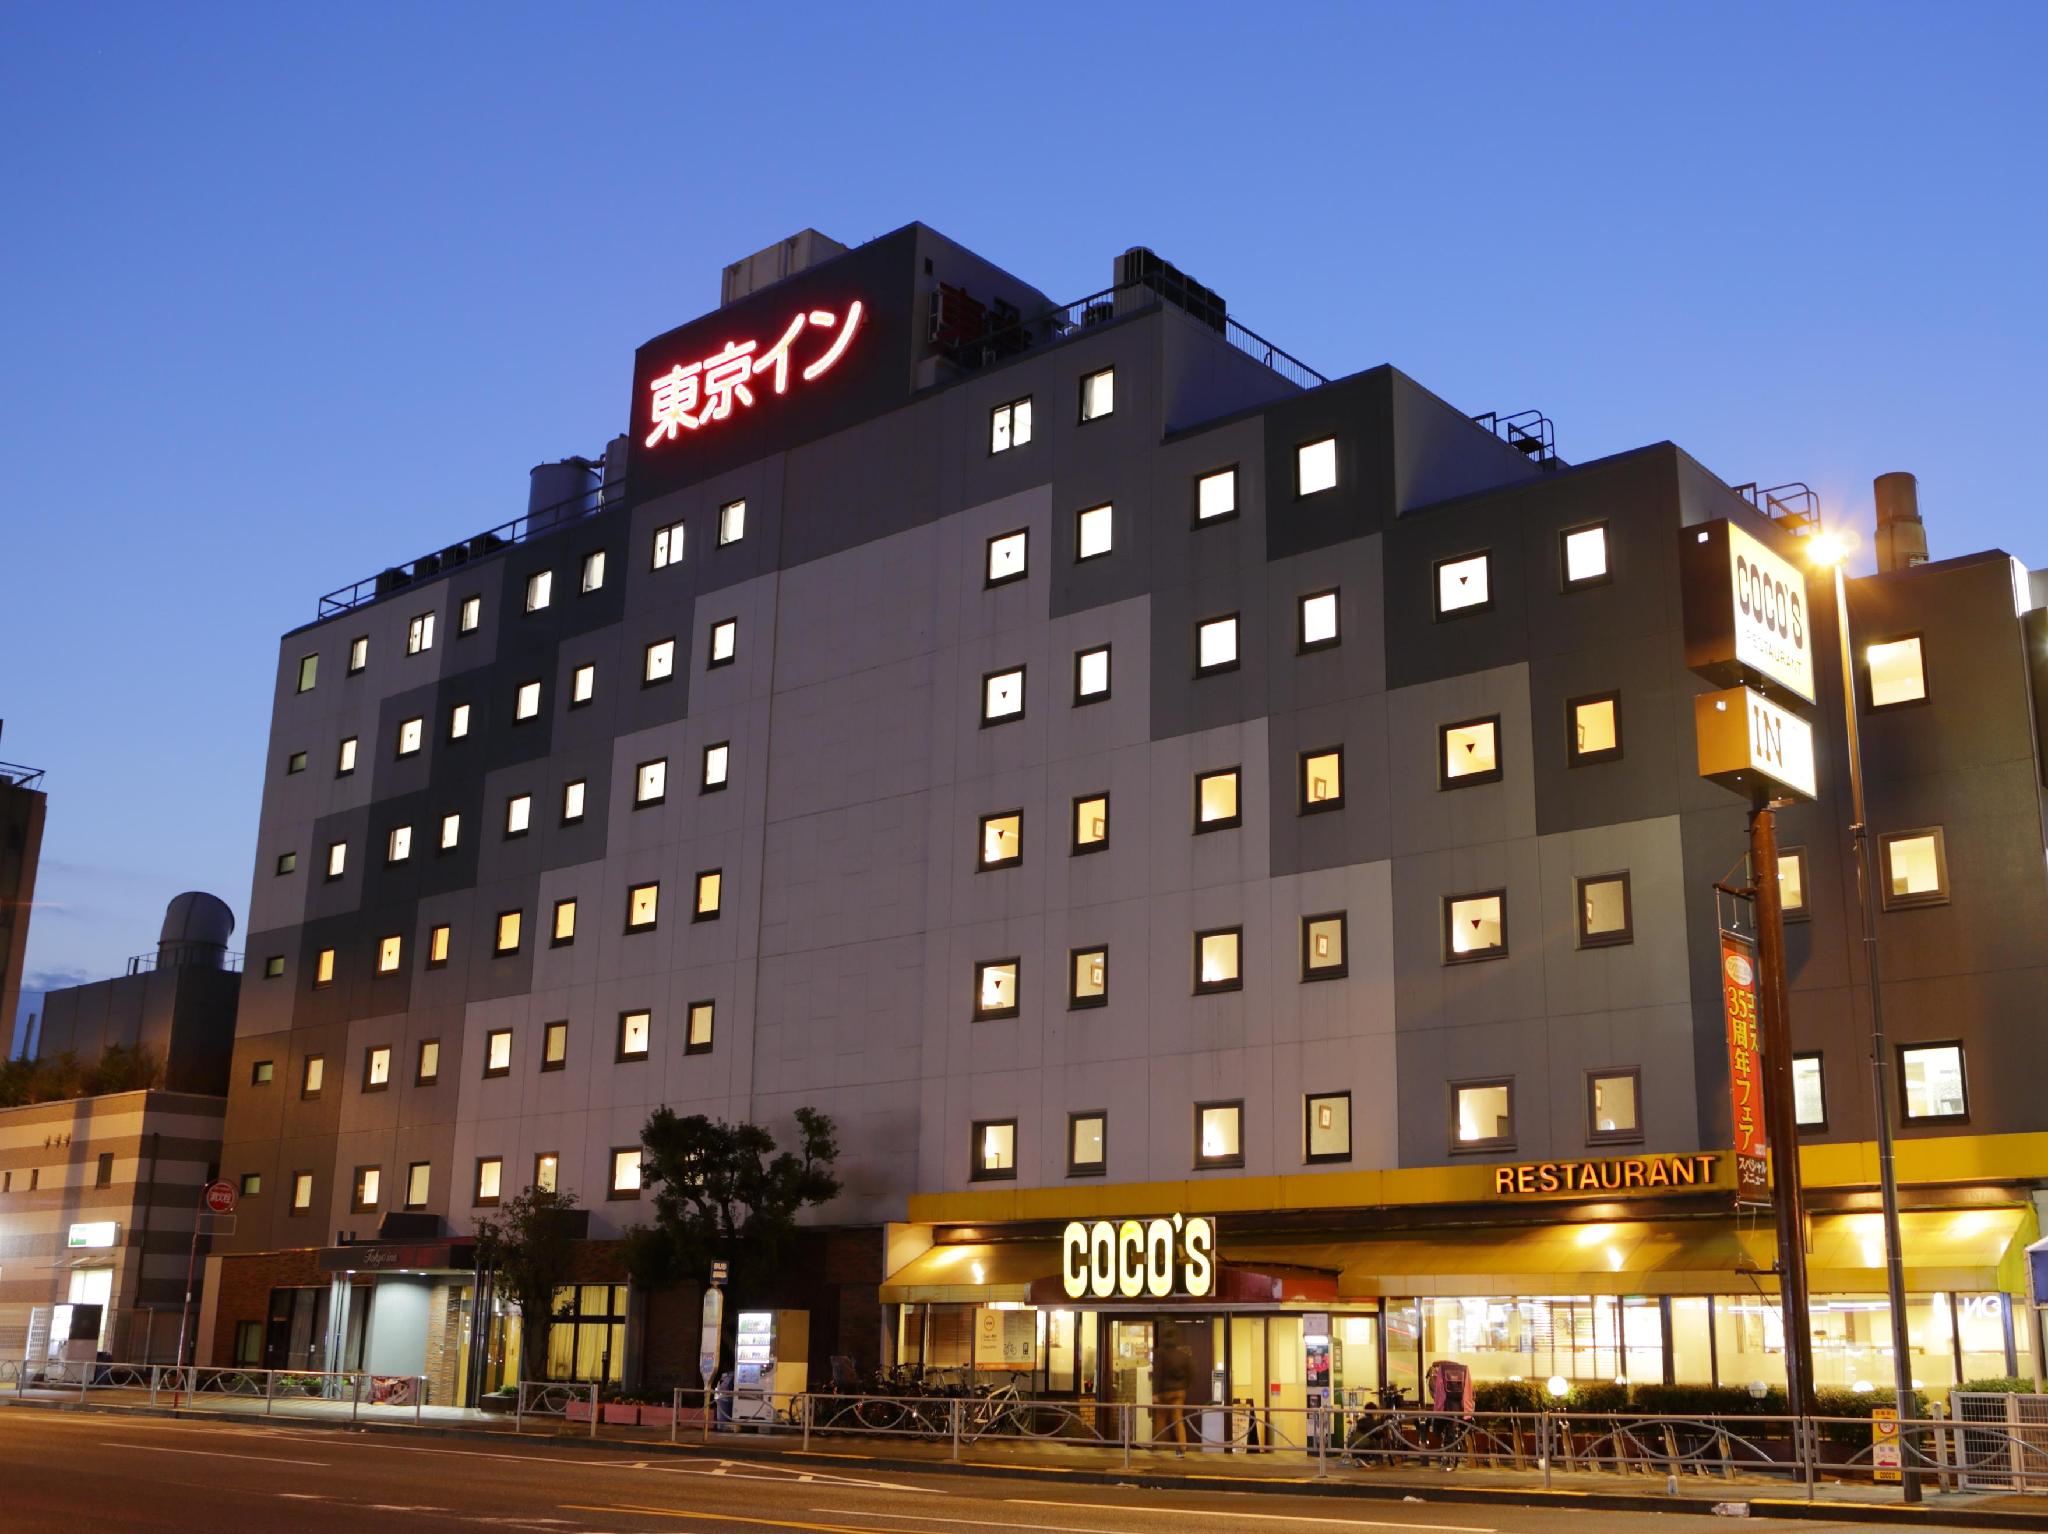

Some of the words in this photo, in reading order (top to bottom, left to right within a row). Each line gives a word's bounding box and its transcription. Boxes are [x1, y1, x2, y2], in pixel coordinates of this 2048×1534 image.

[645, 300, 863, 449] 東京イン
[1737, 554, 1803, 650] COCO'S
[1728, 985, 1754, 1152] 35周年フェア
[1495, 1155, 1716, 1194] RESTAURANT
[1738, 1157, 1767, 1175] スペシャル
[1743, 1171, 1766, 1186] メニュー
[1063, 1212, 1211, 1298] COCO'S
